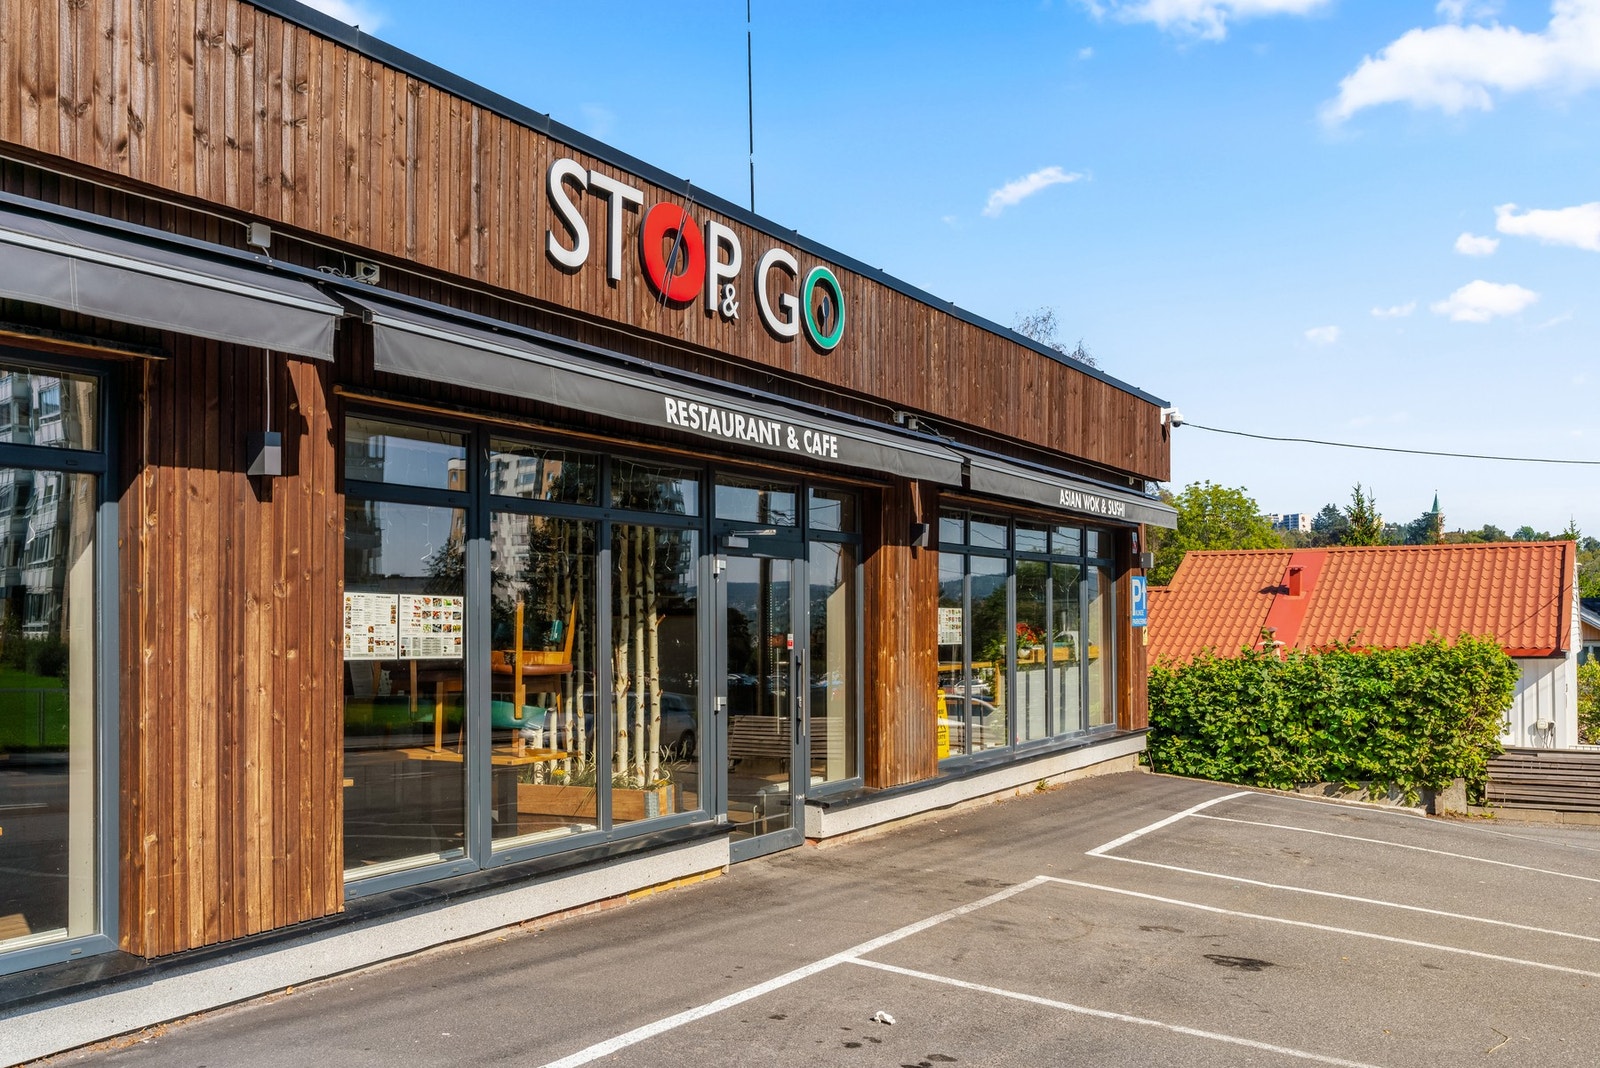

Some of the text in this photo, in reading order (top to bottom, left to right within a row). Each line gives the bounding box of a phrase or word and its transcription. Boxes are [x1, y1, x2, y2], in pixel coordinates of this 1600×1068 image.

[546, 158, 846, 350] STOP & GO
[664, 396, 838, 459] RESTAURANT & CAFE
[1059, 489, 1126, 517] ASIAN WOK & SUSHI
[1132, 579, 1142, 616] P
